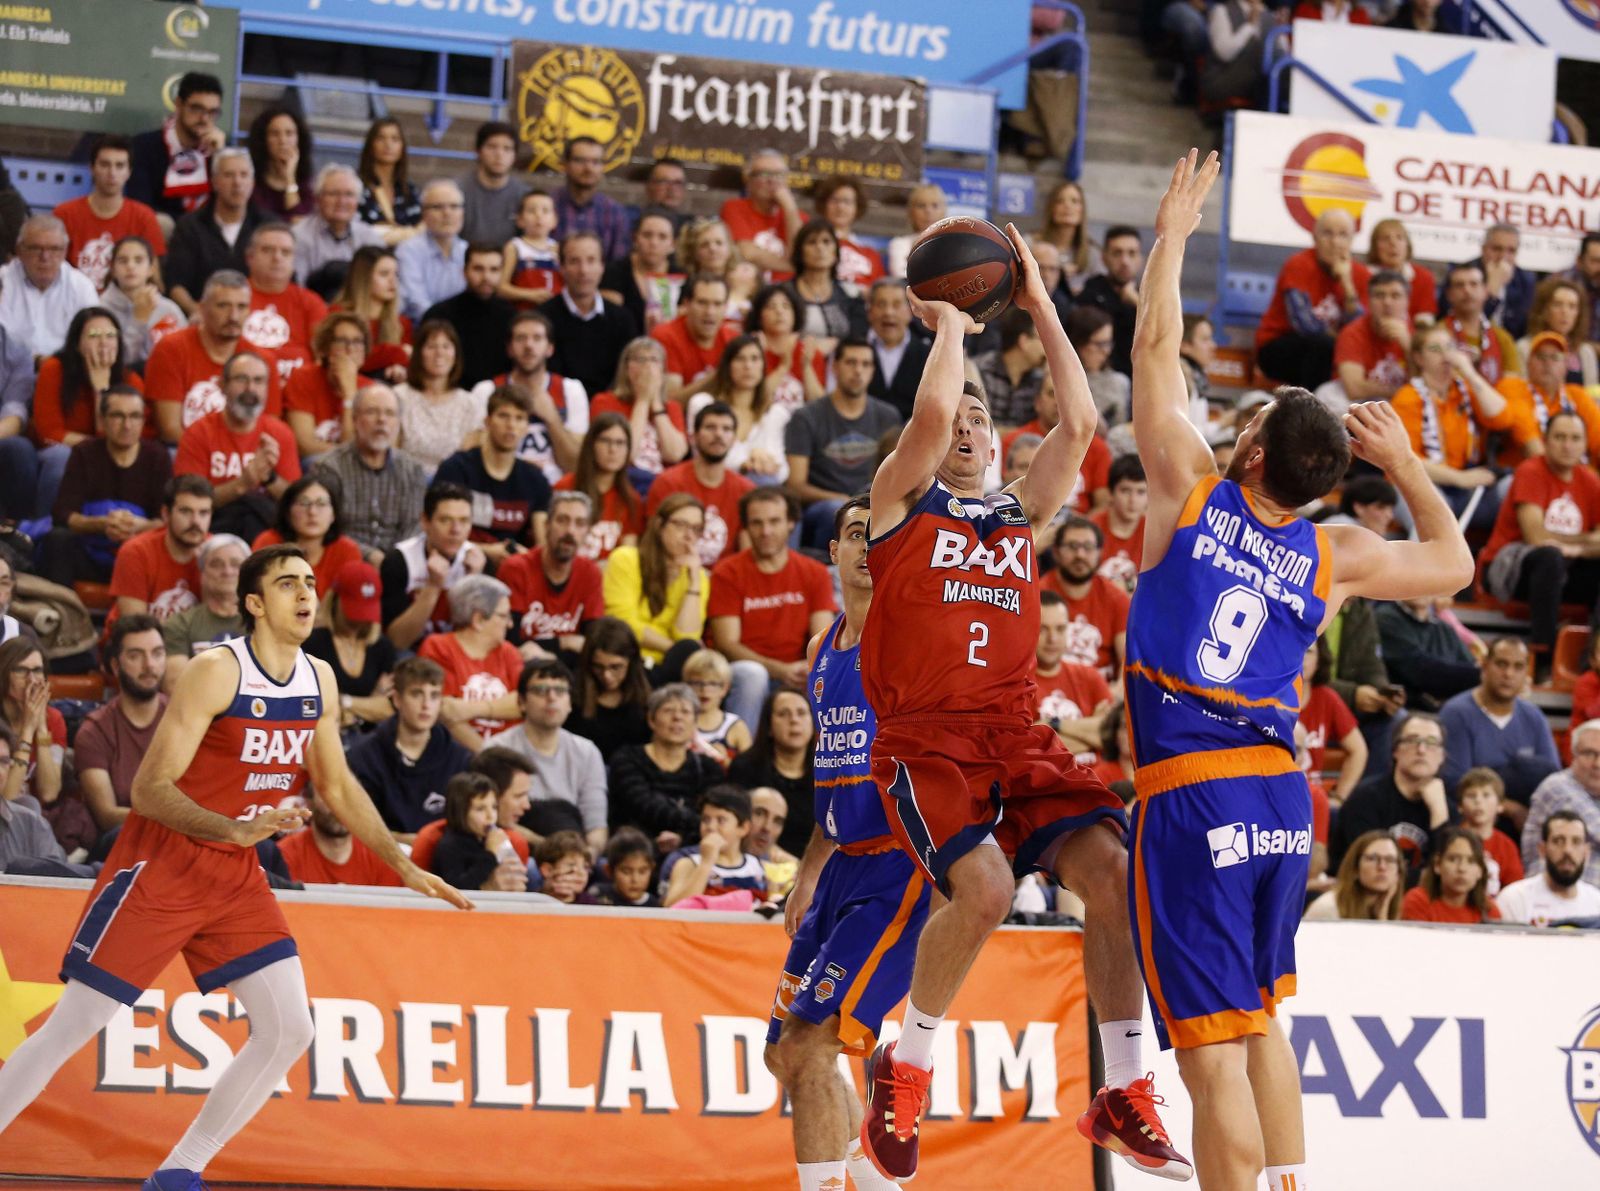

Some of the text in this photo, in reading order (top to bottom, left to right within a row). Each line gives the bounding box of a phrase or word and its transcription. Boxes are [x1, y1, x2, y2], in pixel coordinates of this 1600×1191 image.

[807, 1, 950, 61] futurs
[645, 54, 917, 150] frankfurt
[1006, 188, 1025, 213] 3
[1394, 190, 1442, 218] DE
[1207, 506, 1241, 546] VAN
[930, 529, 1032, 583] BAXI
[943, 579, 1021, 615] MANRESA
[967, 620, 990, 668] 2
[1196, 584, 1268, 684] 9
[1251, 823, 1312, 856] isaval
[96, 988, 1060, 1122] ESRELLA DM
[1290, 1015, 1487, 1118] AXI
